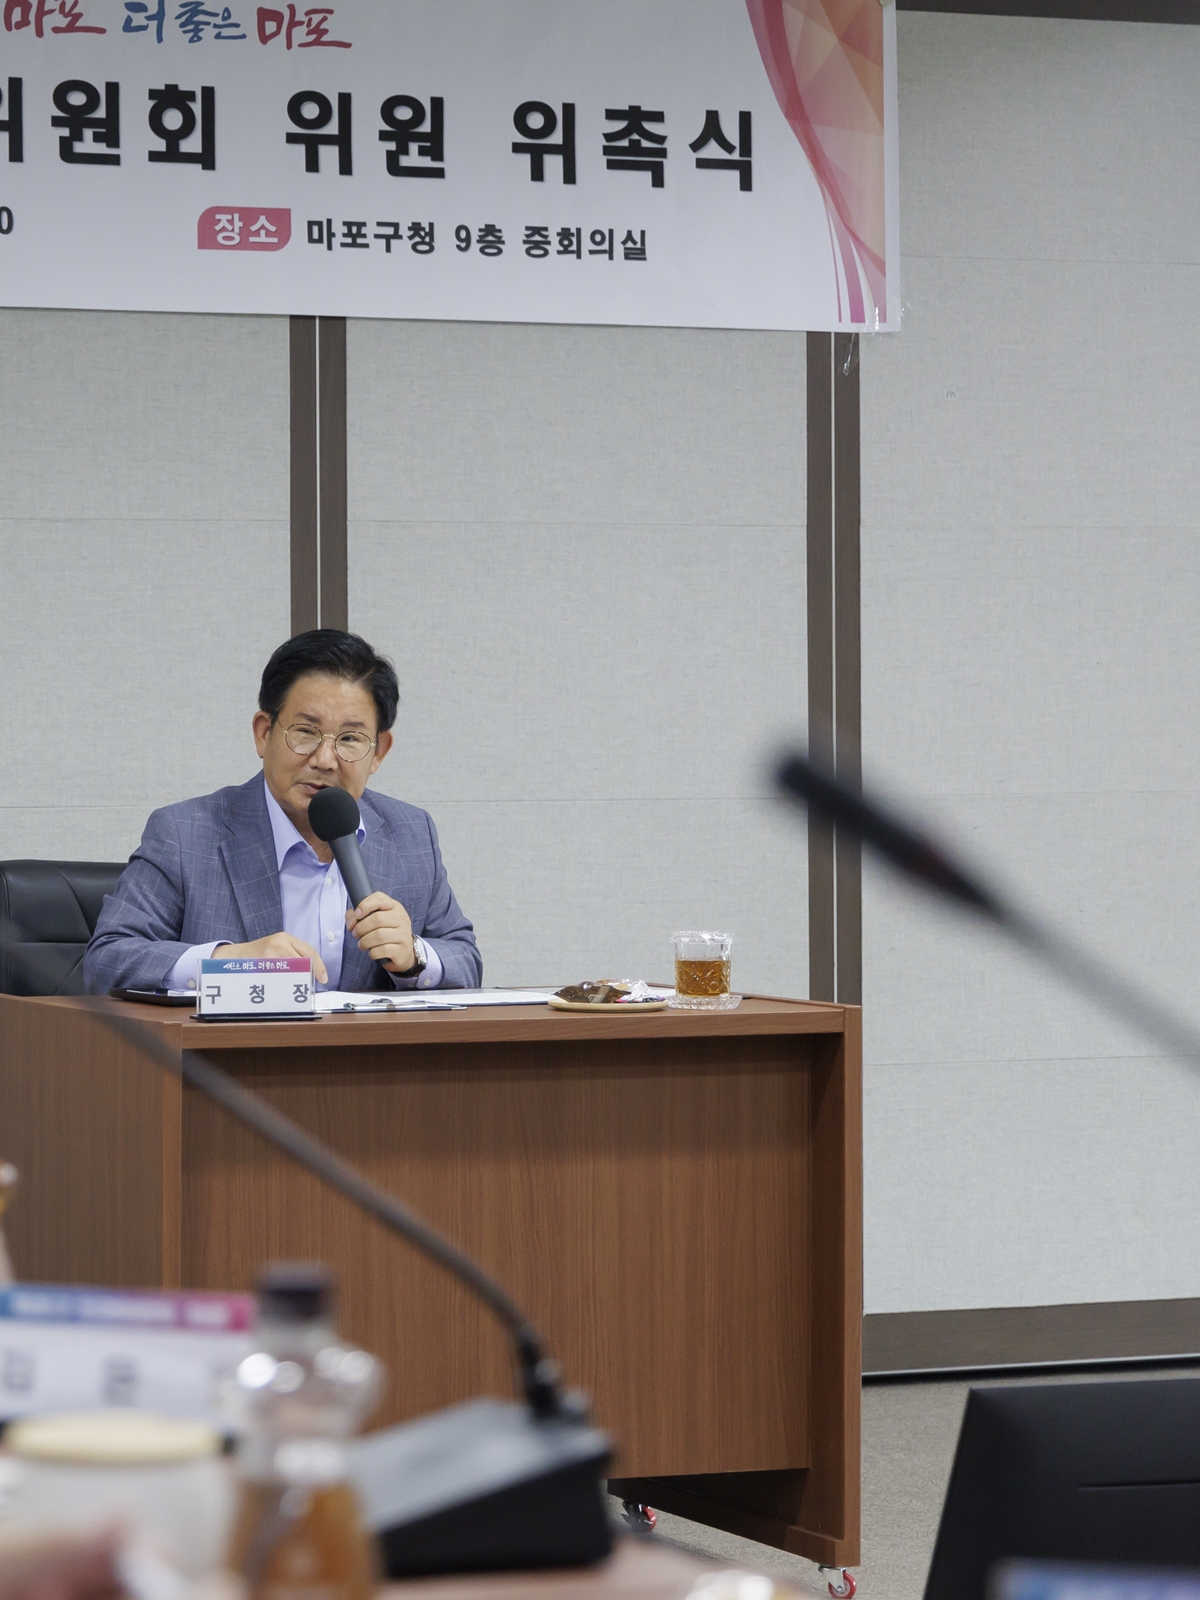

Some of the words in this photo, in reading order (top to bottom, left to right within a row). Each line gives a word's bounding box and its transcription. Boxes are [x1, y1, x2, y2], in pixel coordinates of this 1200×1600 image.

[4, 0, 107, 38] 마포
[122, 0, 165, 44] 더
[174, 1, 247, 43] 좋은
[257, 3, 353, 50] 마포
[285, 90, 446, 180] 위원
[511, 100, 754, 192] 위촉식
[214, 213, 279, 246] 장소
[306, 217, 435, 255] 마포구청
[454, 223, 506, 257] 9층
[522, 226, 648, 261] 중회의실
